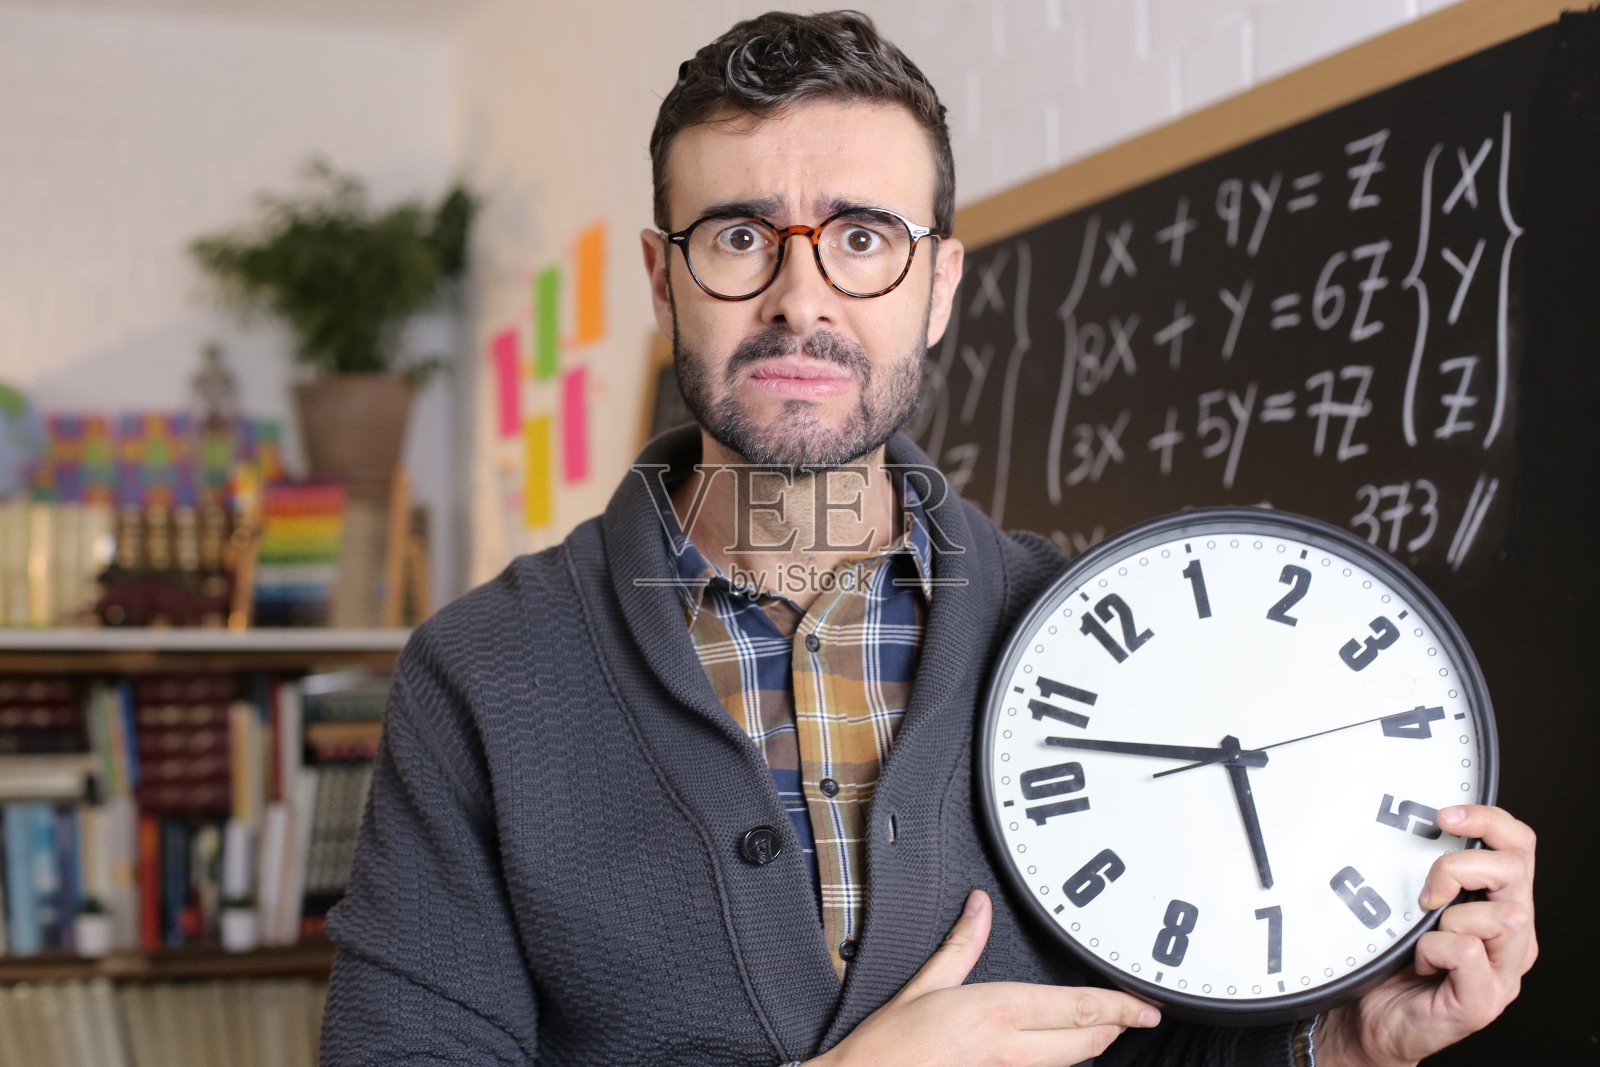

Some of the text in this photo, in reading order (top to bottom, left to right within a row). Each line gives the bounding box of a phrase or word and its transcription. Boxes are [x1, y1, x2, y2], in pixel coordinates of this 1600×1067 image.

[1099, 220, 1138, 287] X
[1344, 128, 1391, 211] Z
[1442, 137, 1494, 214] X
[1441, 239, 1486, 324] Y
[1434, 355, 1479, 440] Z
[1349, 478, 1439, 554] 373
[1182, 559, 1212, 619] 1
[1266, 564, 1311, 627] 2
[1080, 593, 1155, 664] 12
[1338, 615, 1400, 672] 3
[1027, 676, 1098, 729] 11
[1380, 705, 1445, 739] 4
[1020, 761, 1090, 826] 10
[1376, 793, 1443, 840] 5
[1062, 848, 1126, 908] 9
[1329, 865, 1392, 930] 6
[1152, 899, 1199, 967] 8
[1254, 905, 1283, 975] 7
